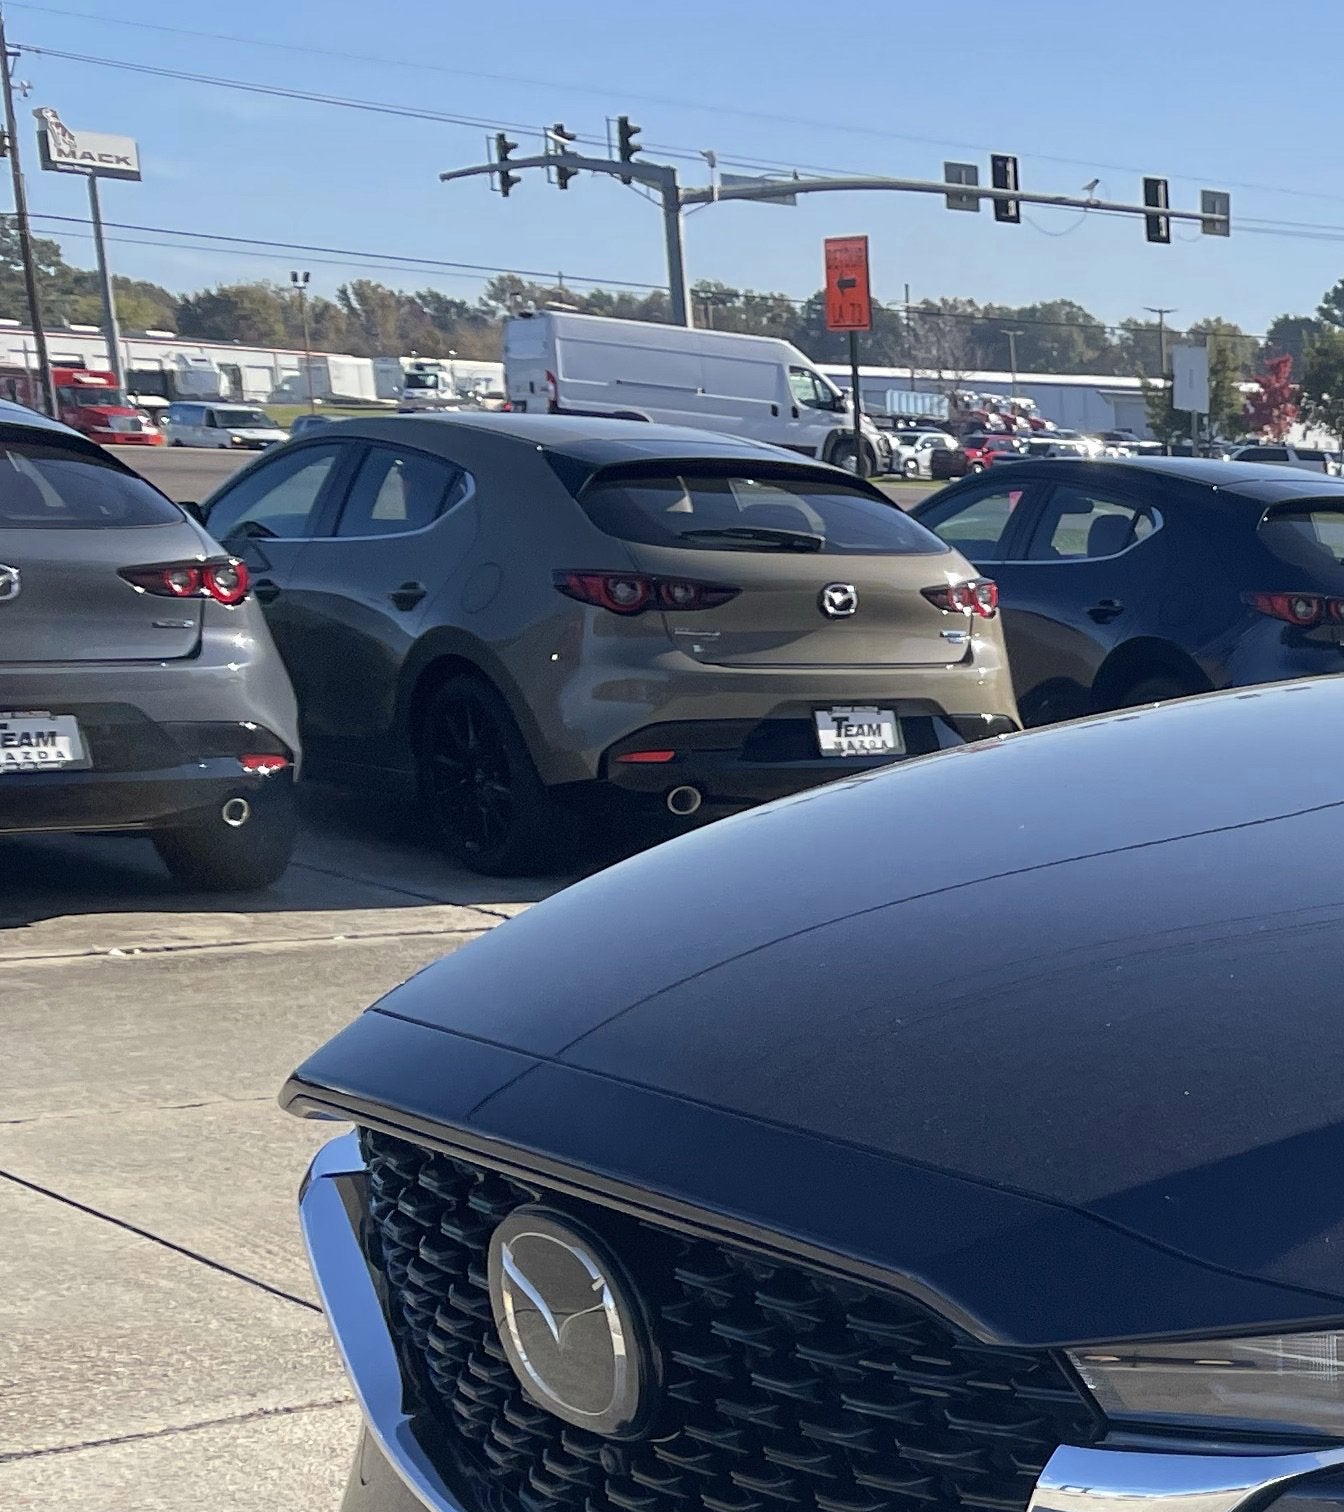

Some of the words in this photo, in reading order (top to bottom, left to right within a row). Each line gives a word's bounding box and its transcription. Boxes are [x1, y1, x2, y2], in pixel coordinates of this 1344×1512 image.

[56, 147, 132, 166] MACK
[831, 716, 882, 738] TEAM
[3, 750, 66, 761] AZDA
